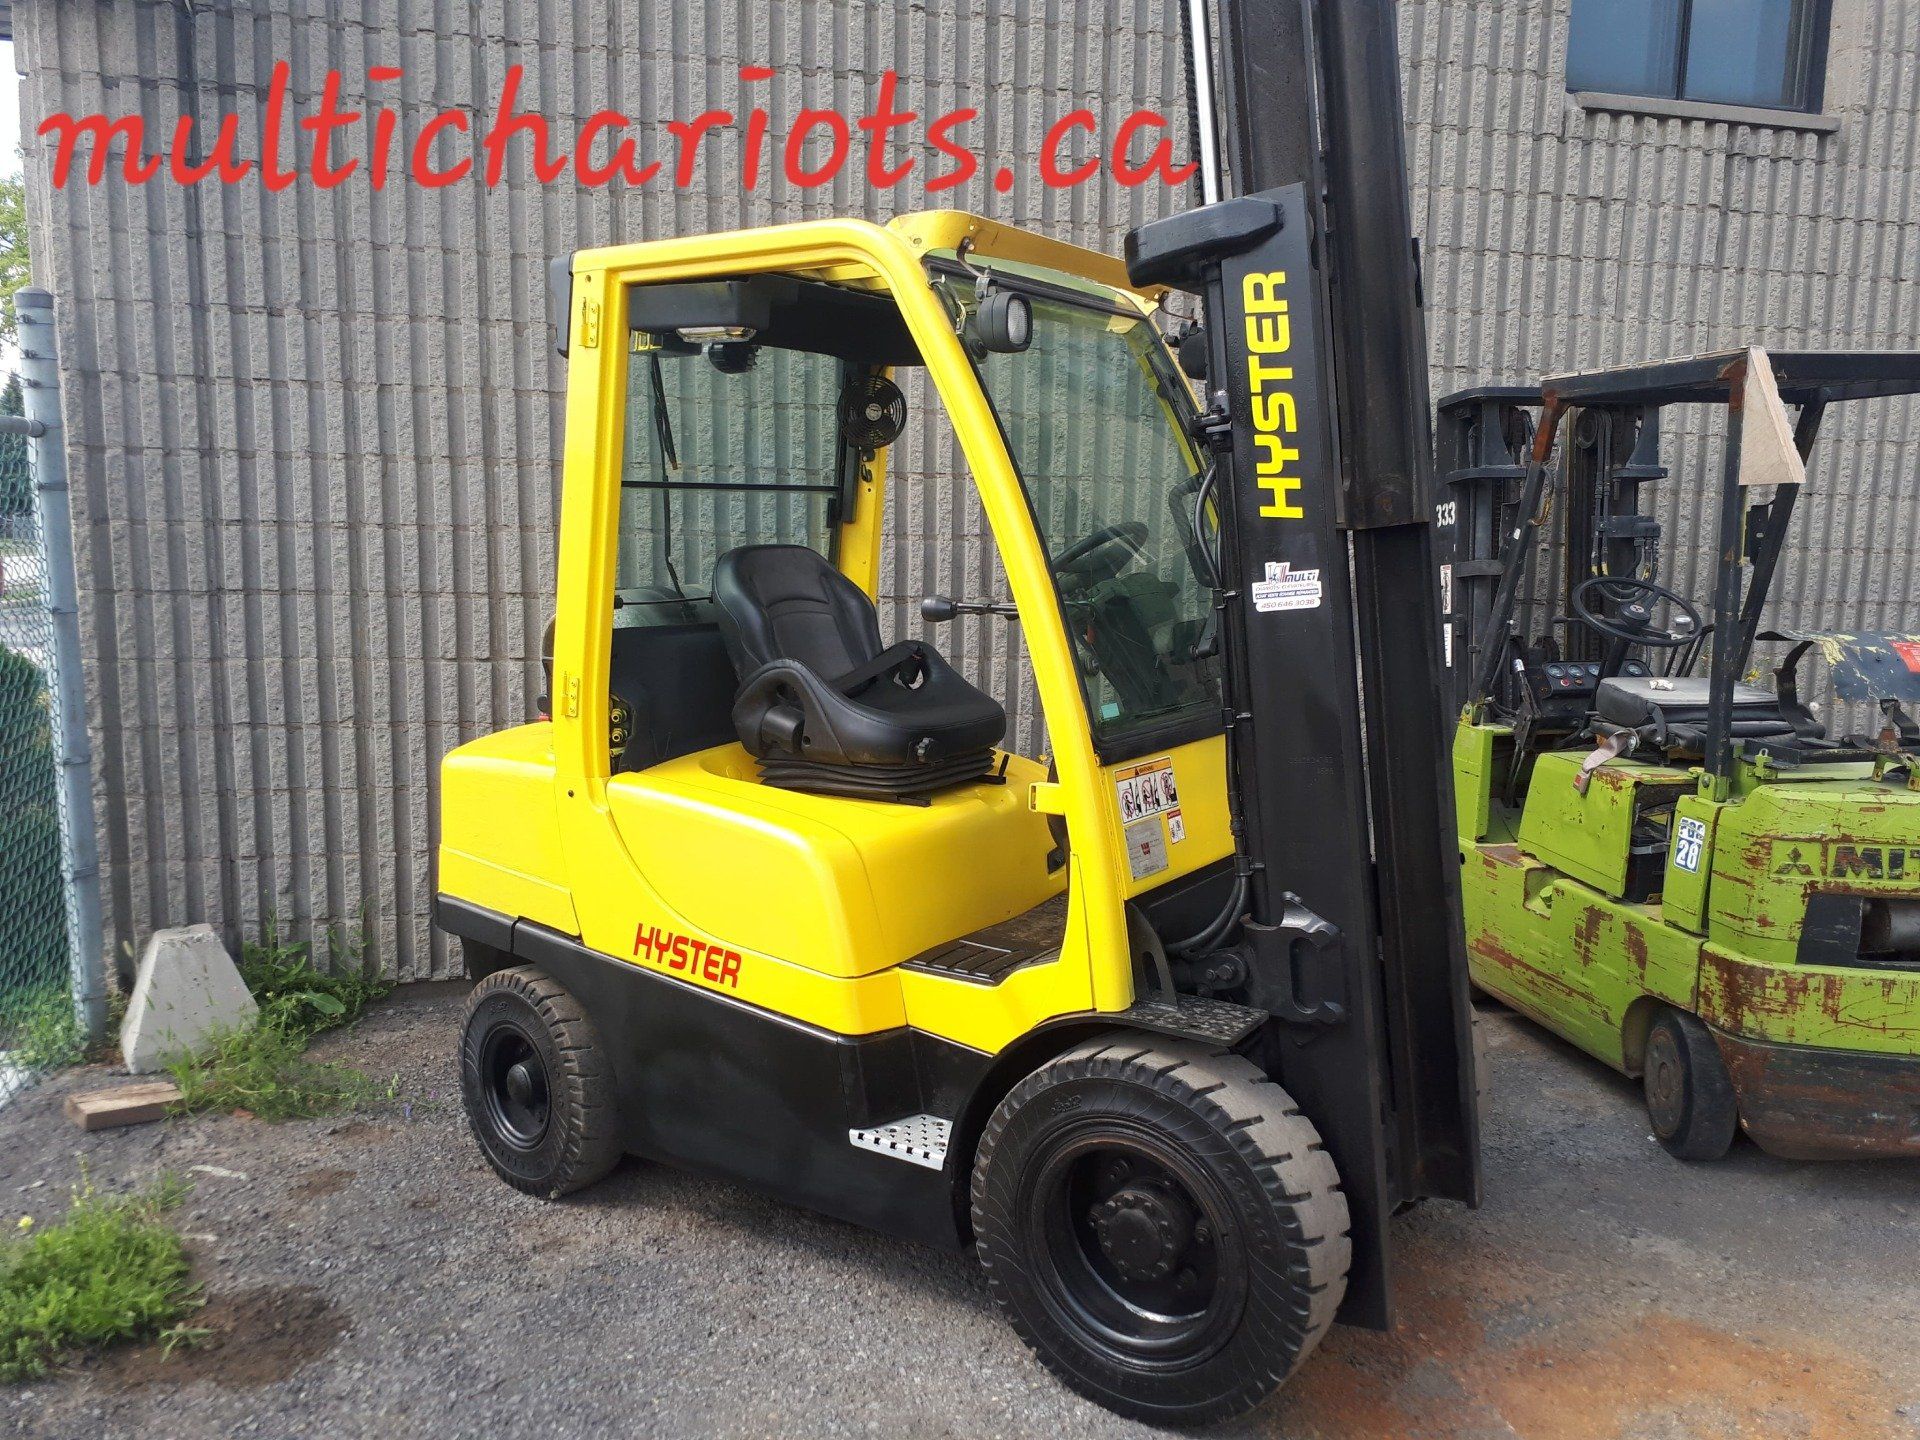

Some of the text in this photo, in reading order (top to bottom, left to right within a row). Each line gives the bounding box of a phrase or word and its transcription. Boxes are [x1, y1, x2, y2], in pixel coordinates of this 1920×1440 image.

[1242, 271, 1304, 519] HYSTER
[1435, 501, 1456, 528] 333
[1277, 600, 1294, 608] 646
[633, 922, 742, 989] HYSTER
